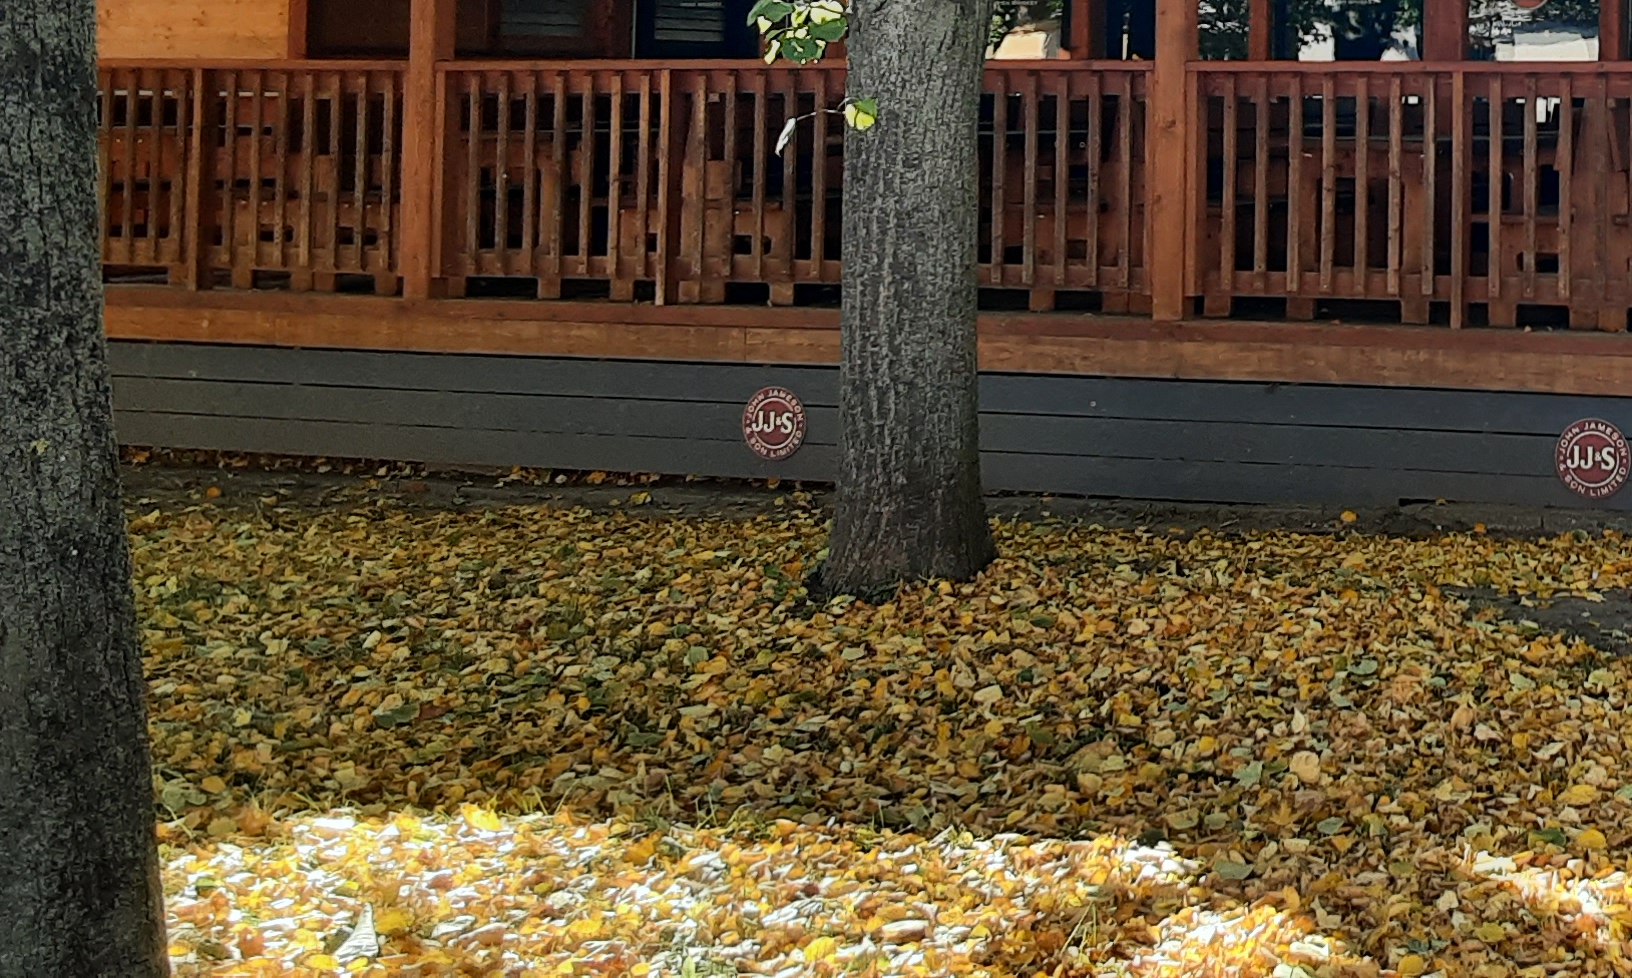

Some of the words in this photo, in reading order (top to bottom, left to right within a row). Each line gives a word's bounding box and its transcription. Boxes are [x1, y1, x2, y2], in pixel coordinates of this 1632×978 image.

[1559, 426, 1580, 455] JOHN
[1583, 422, 1628, 457] JAMESON
[1566, 445, 1616, 471] JJ&S
[1564, 474, 1586, 495] SON
[1589, 467, 1627, 497] LIMITED
